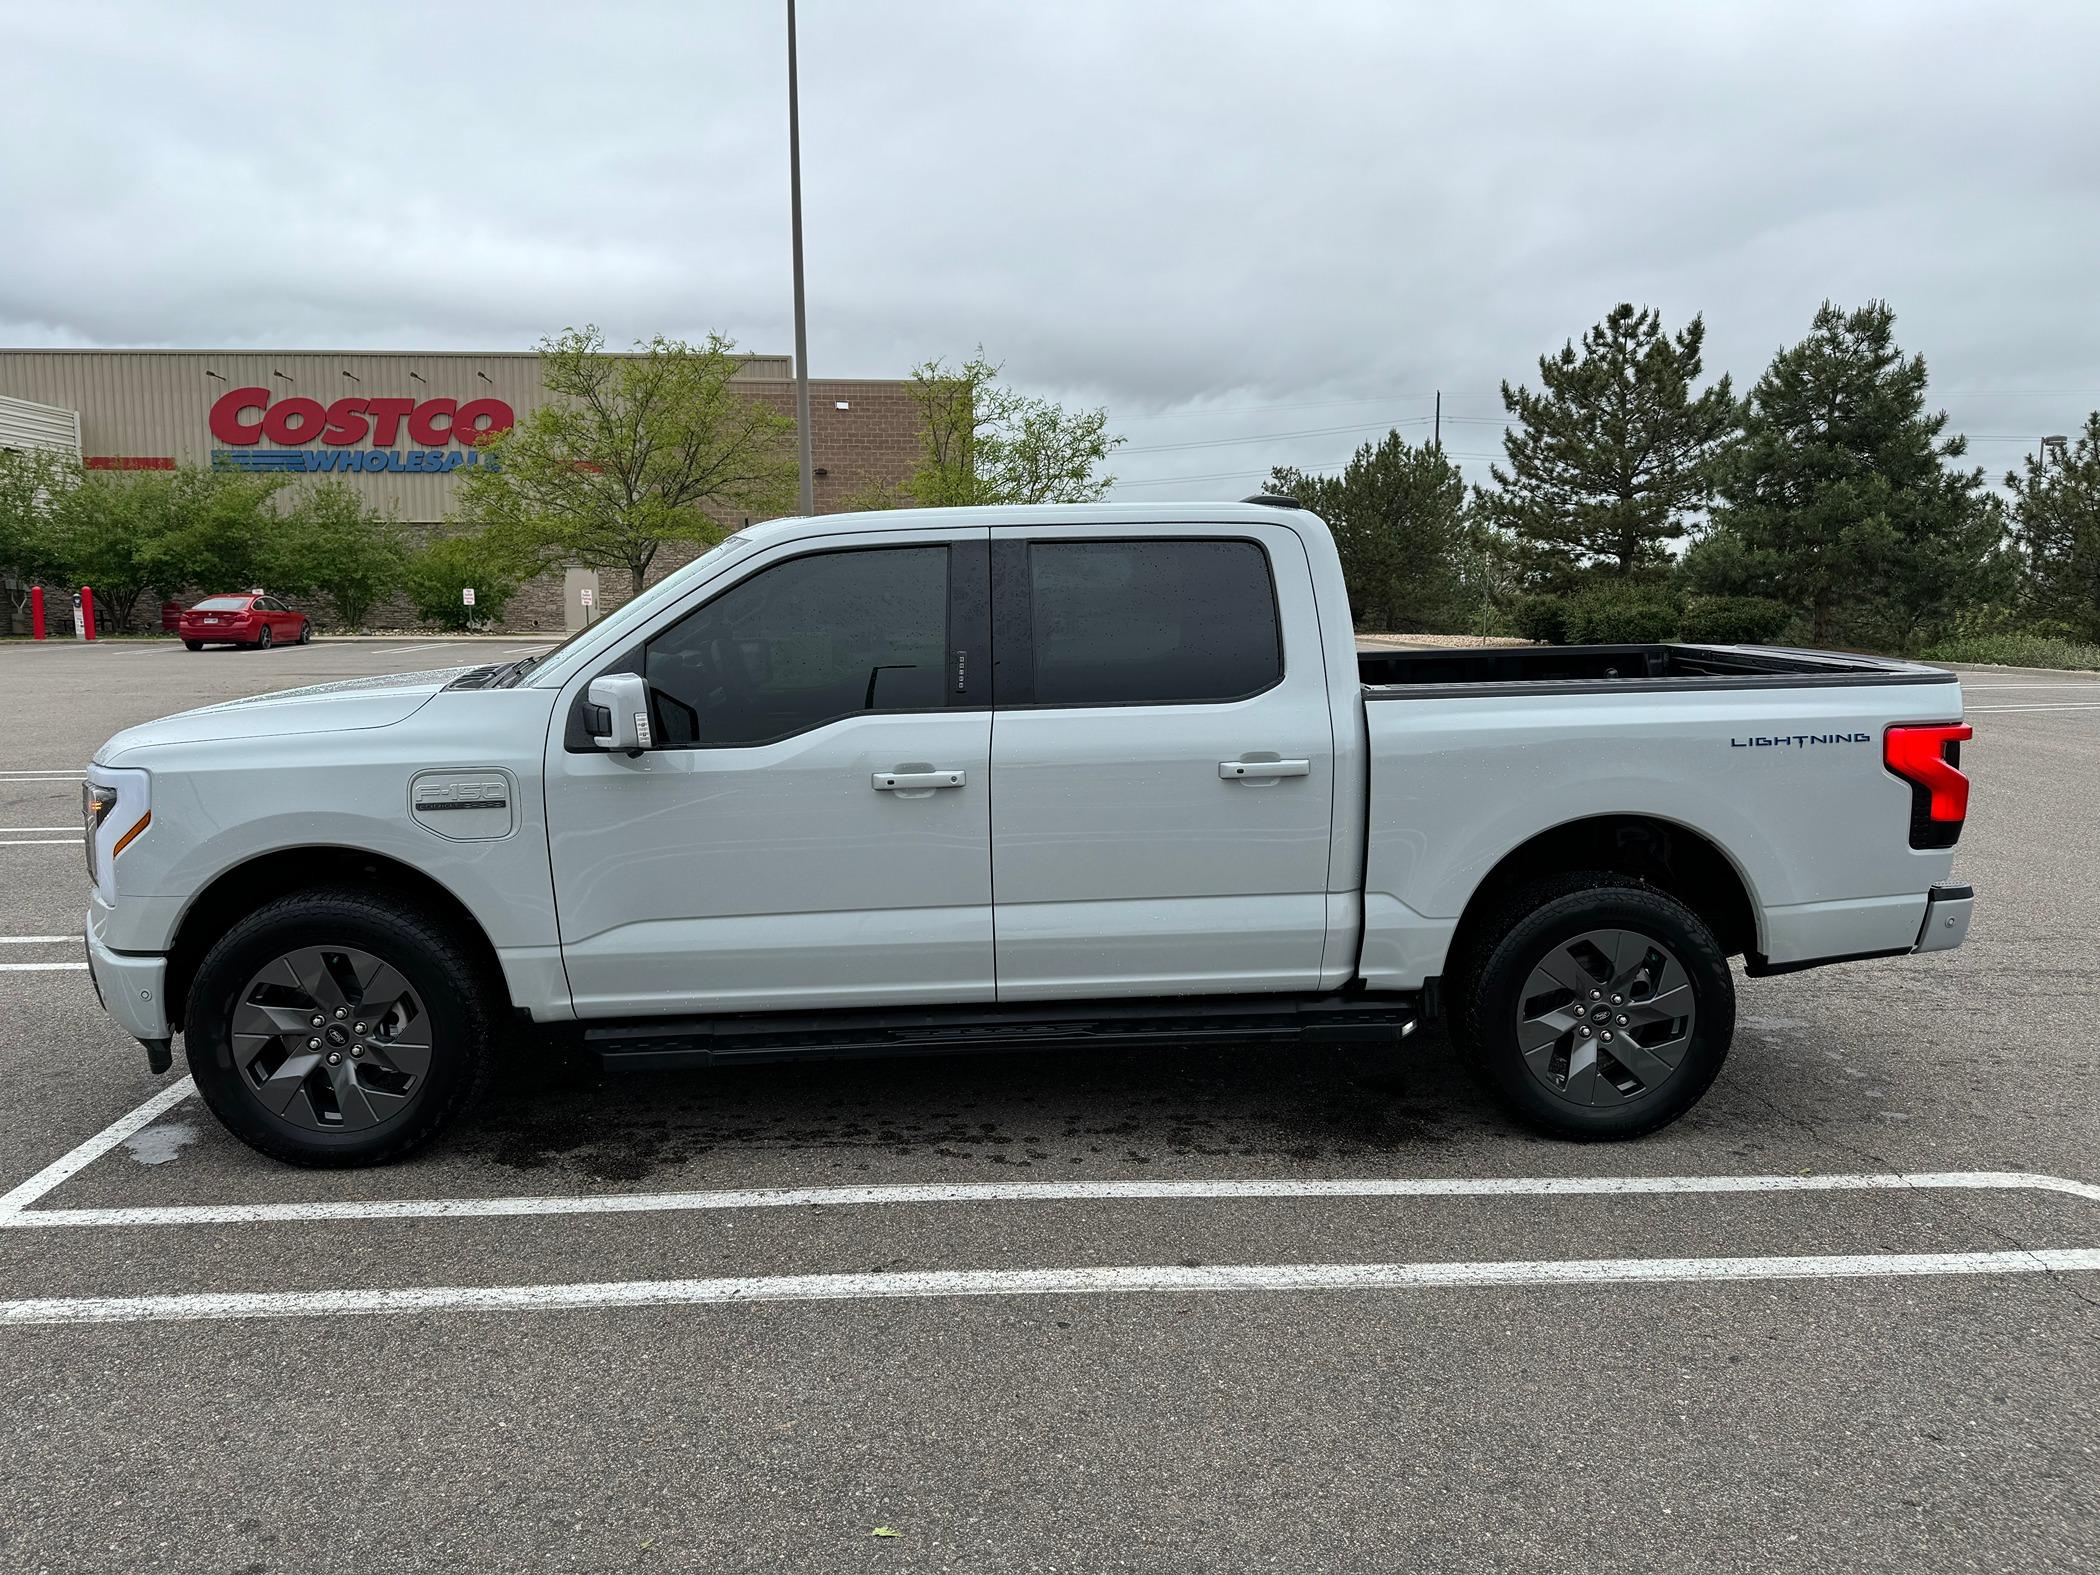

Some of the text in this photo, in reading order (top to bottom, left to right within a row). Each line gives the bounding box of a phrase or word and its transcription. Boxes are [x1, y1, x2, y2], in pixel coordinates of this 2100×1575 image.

[209, 387, 514, 446] COSTCO
[1731, 733, 1871, 748] LIGHTNING
[415, 782, 505, 801] F-150
